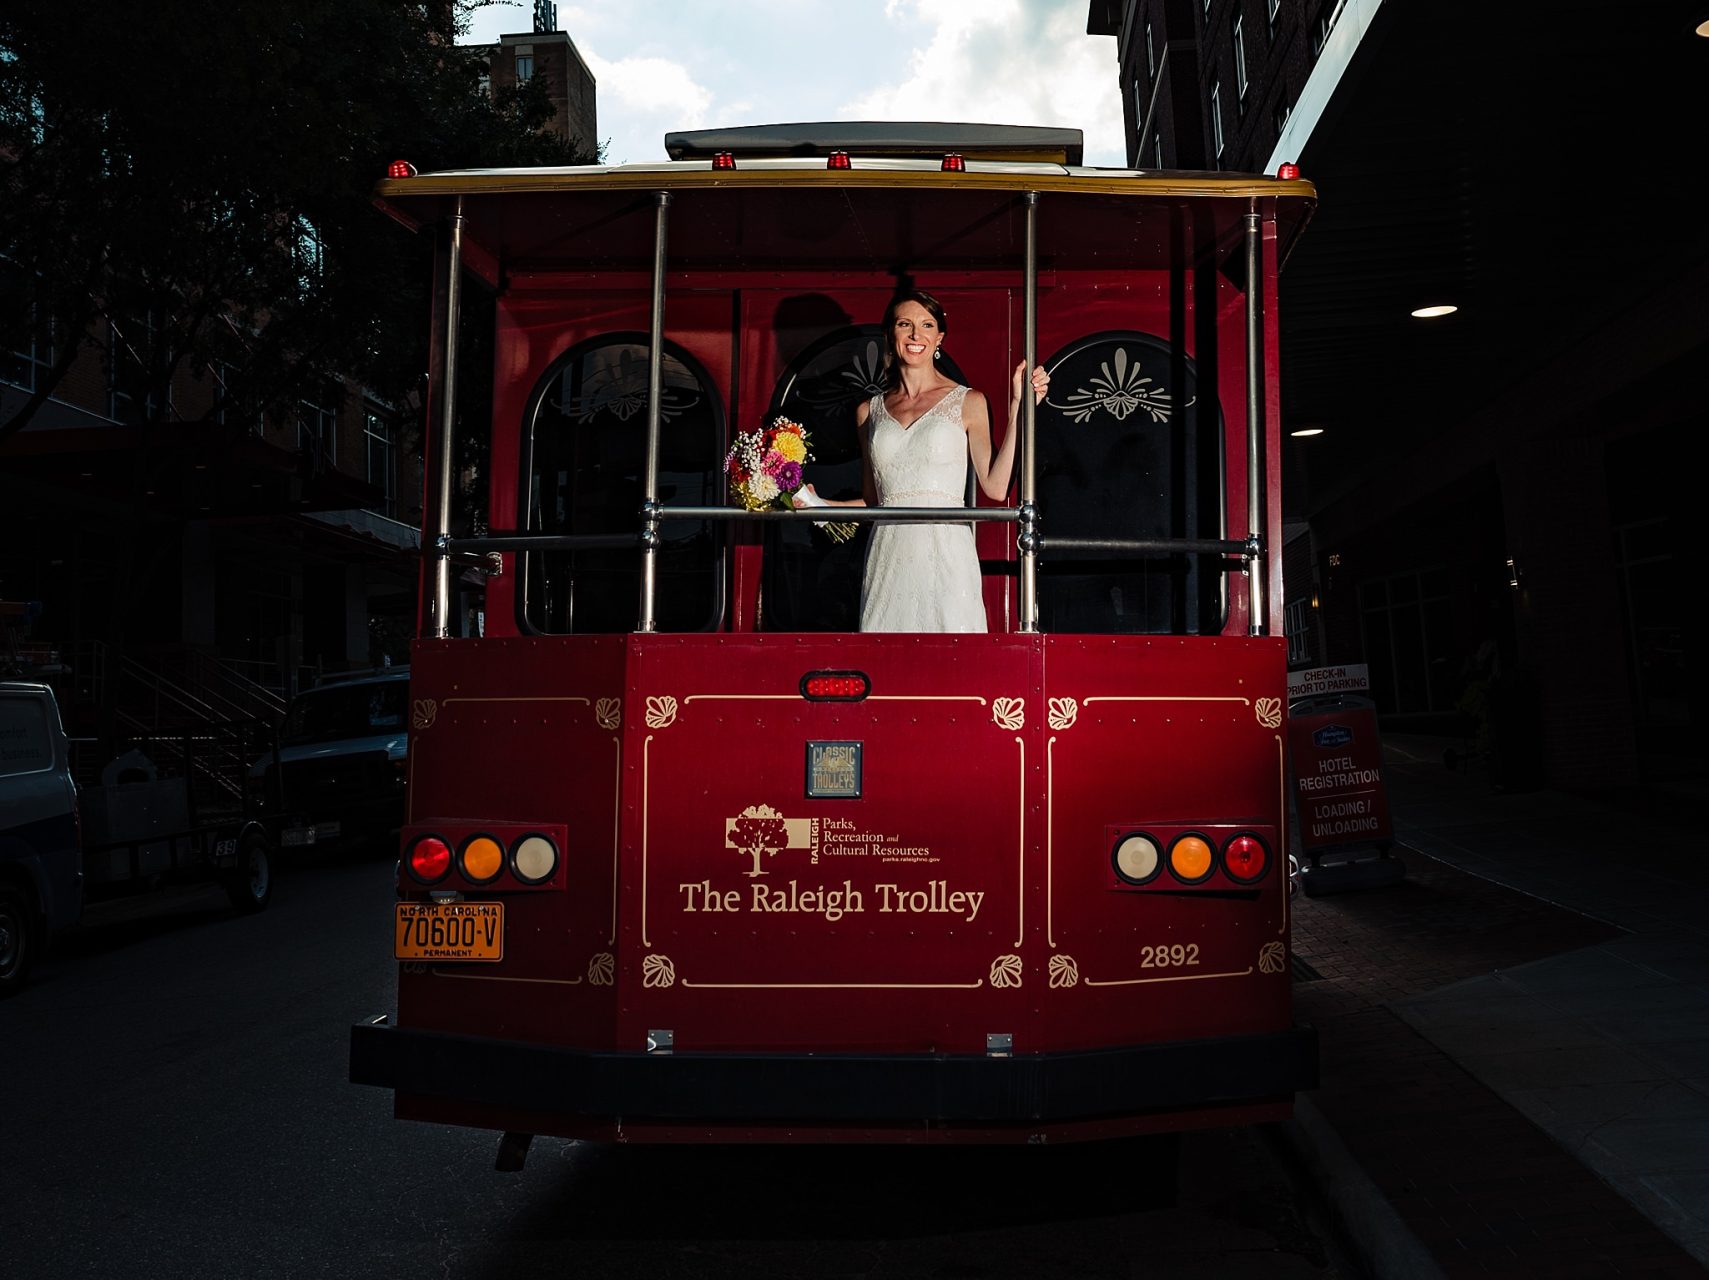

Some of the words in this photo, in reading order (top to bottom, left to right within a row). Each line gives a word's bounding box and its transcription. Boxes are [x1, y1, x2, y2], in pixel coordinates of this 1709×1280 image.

[1304, 668, 1346, 682] CHECK-IN
[1314, 682, 1326, 691] TO
[1327, 678, 1367, 689] PARKING
[1319, 757, 1356, 773] HOTEL
[813, 773, 854, 788] TROLLEYS
[1300, 770, 1380, 791] REGISTRATION
[1315, 802, 1365, 819] LOADING
[823, 818, 856, 830] Parks,
[1312, 817, 1379, 837] UNLOADING
[811, 818, 819, 864] RALEIGH
[824, 830, 884, 842] Recreation
[886, 834, 899, 842] and
[823, 844, 868, 855] Cultural
[872, 844, 930, 855] Resources
[679, 880, 741, 912] The
[751, 880, 864, 922] Raleigh
[875, 880, 985, 922] Trolley
[400, 907, 439, 916] NORTH
[444, 907, 497, 916] CAROLINA
[401, 917, 497, 947] 70600-V
[424, 949, 472, 957] PERMANENT
[1141, 943, 1200, 968] 2892
